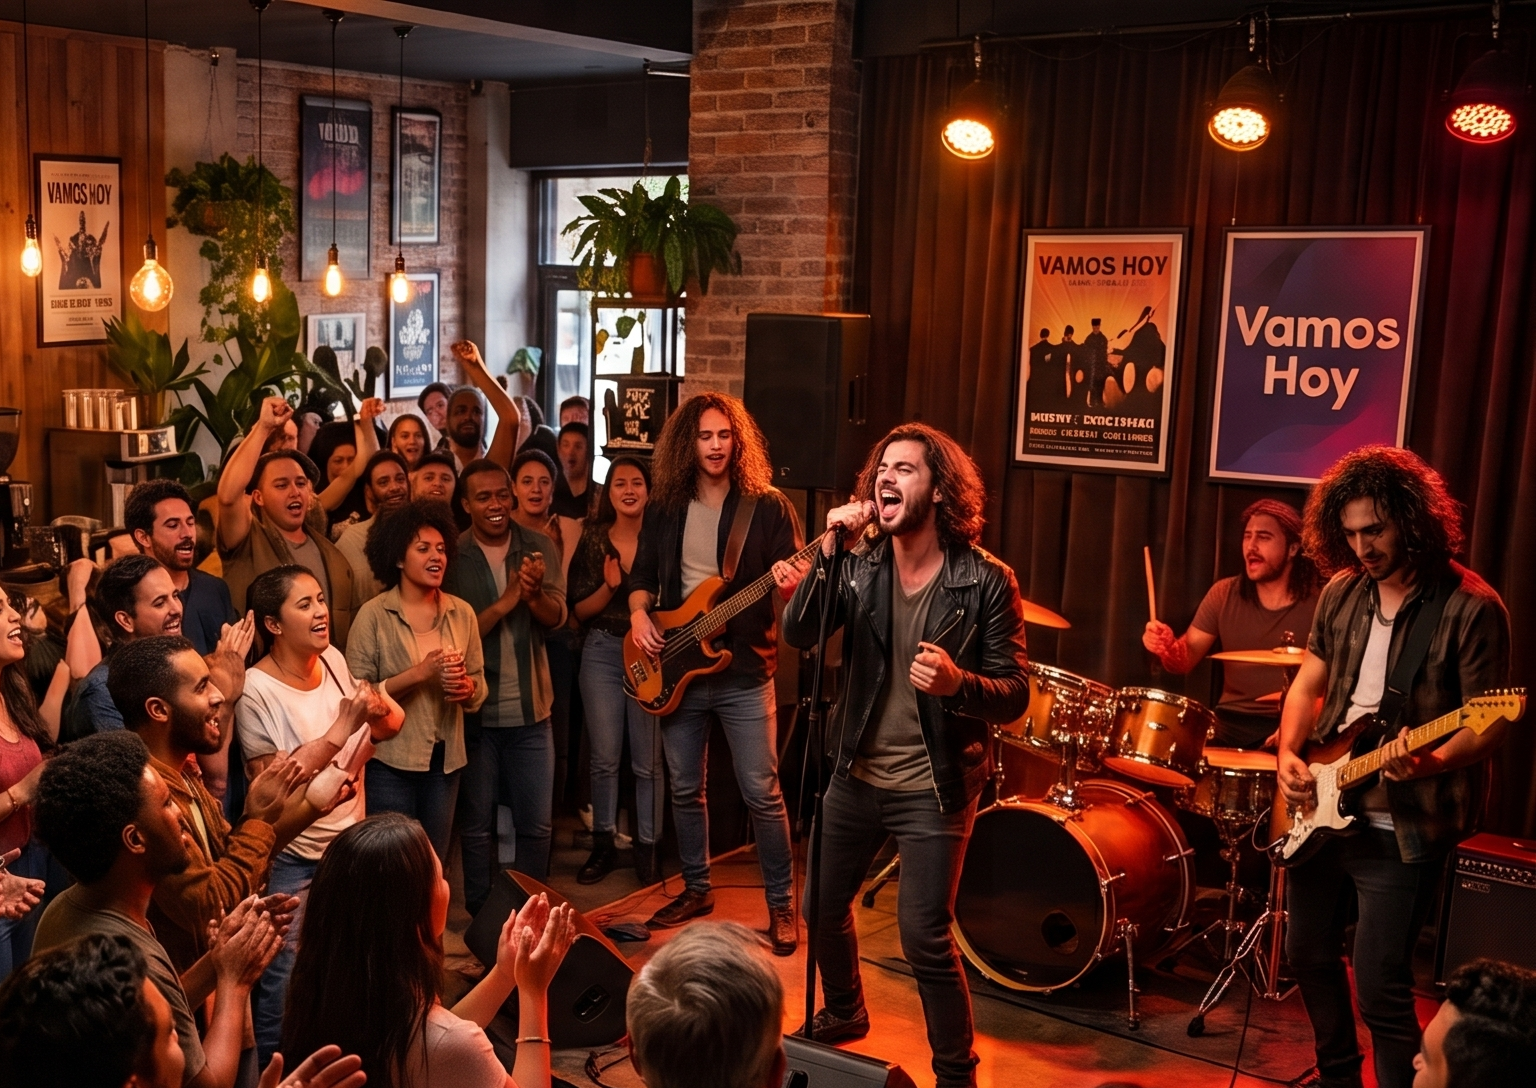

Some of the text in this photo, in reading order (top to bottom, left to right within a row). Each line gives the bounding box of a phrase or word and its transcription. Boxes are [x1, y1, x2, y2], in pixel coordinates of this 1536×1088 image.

[1038, 255, 1169, 276] VAMOS HOY
[1235, 305, 1401, 350] Vamos
[1263, 355, 1360, 410] Hoy
